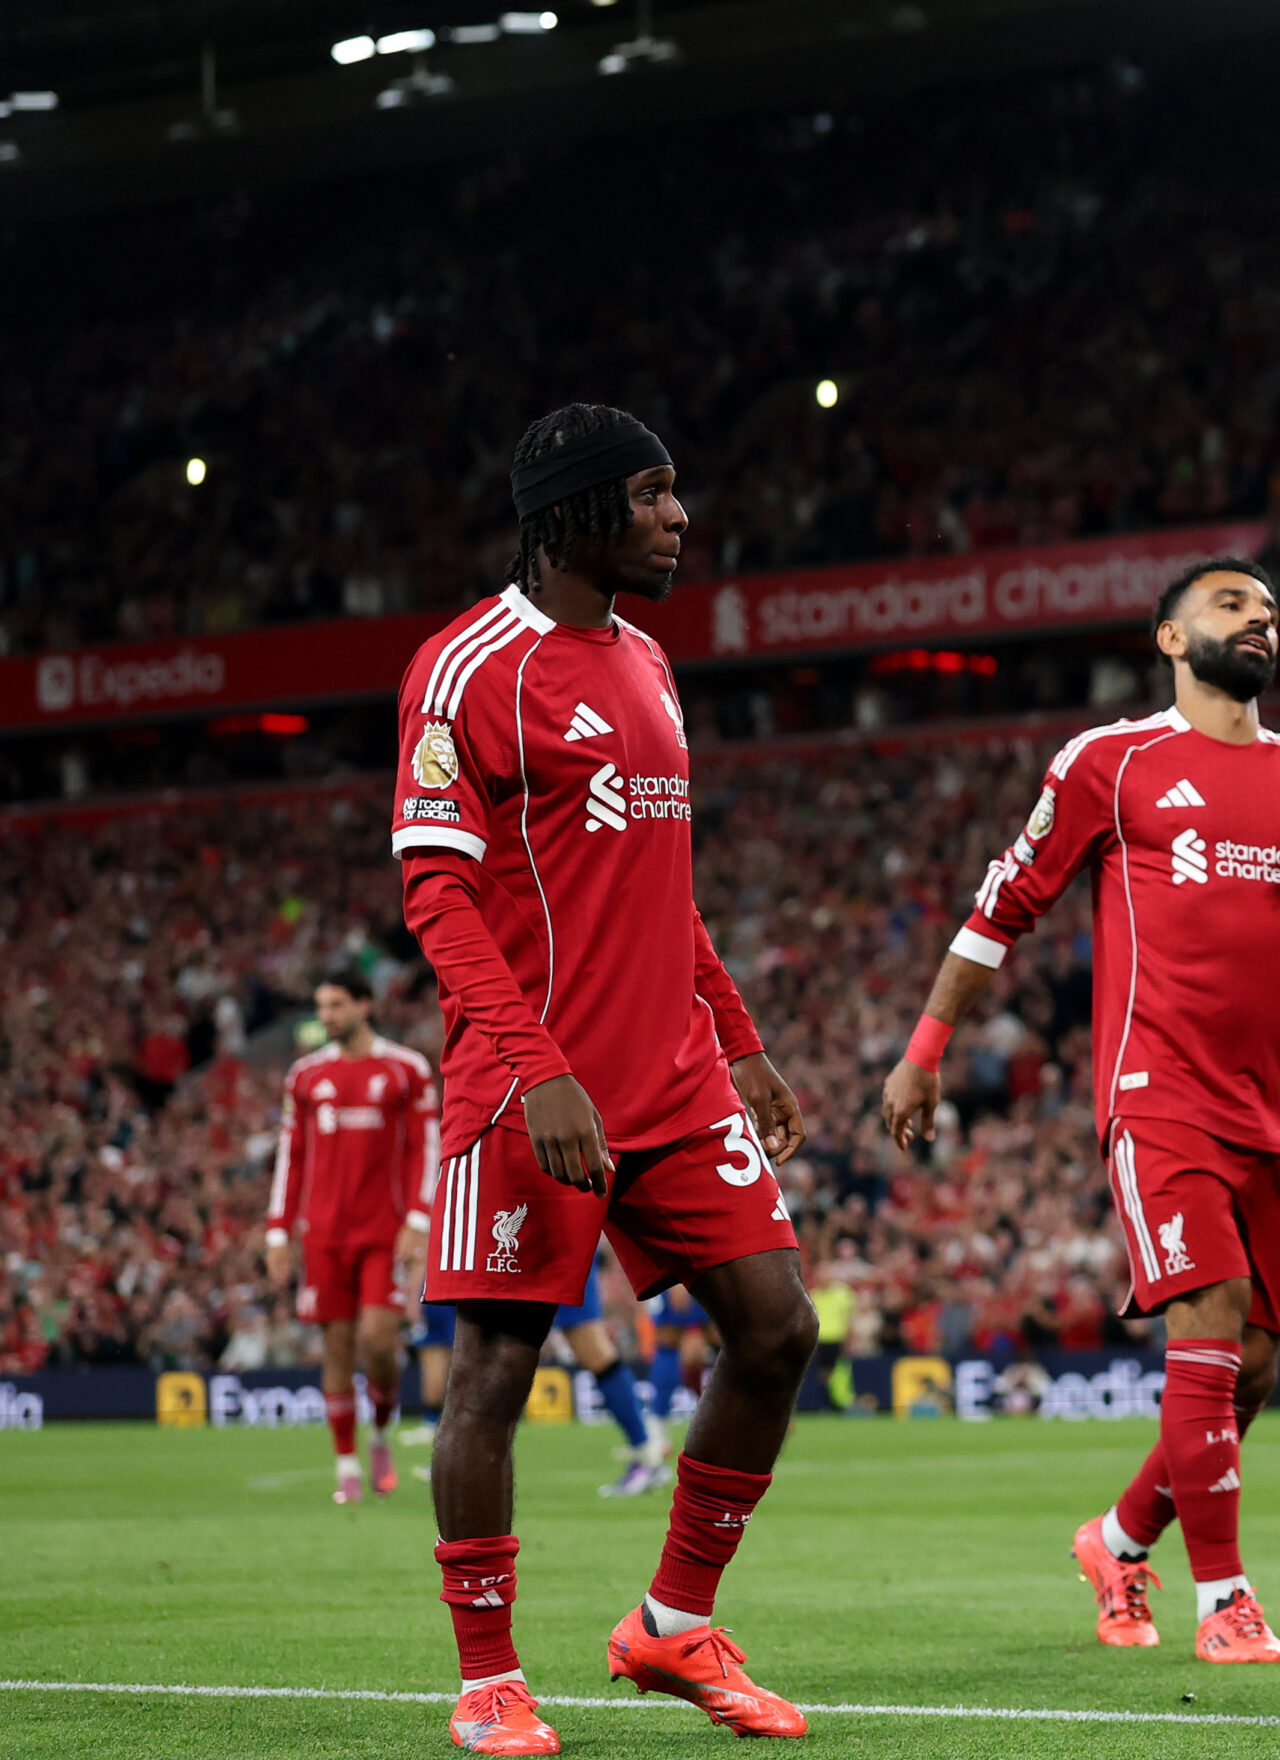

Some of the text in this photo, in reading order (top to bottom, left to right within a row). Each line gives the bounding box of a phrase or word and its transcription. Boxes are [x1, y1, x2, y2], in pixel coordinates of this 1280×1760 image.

[758, 567, 988, 645] standard
[403, 797, 456, 812] No room
[416, 809, 461, 823] racism
